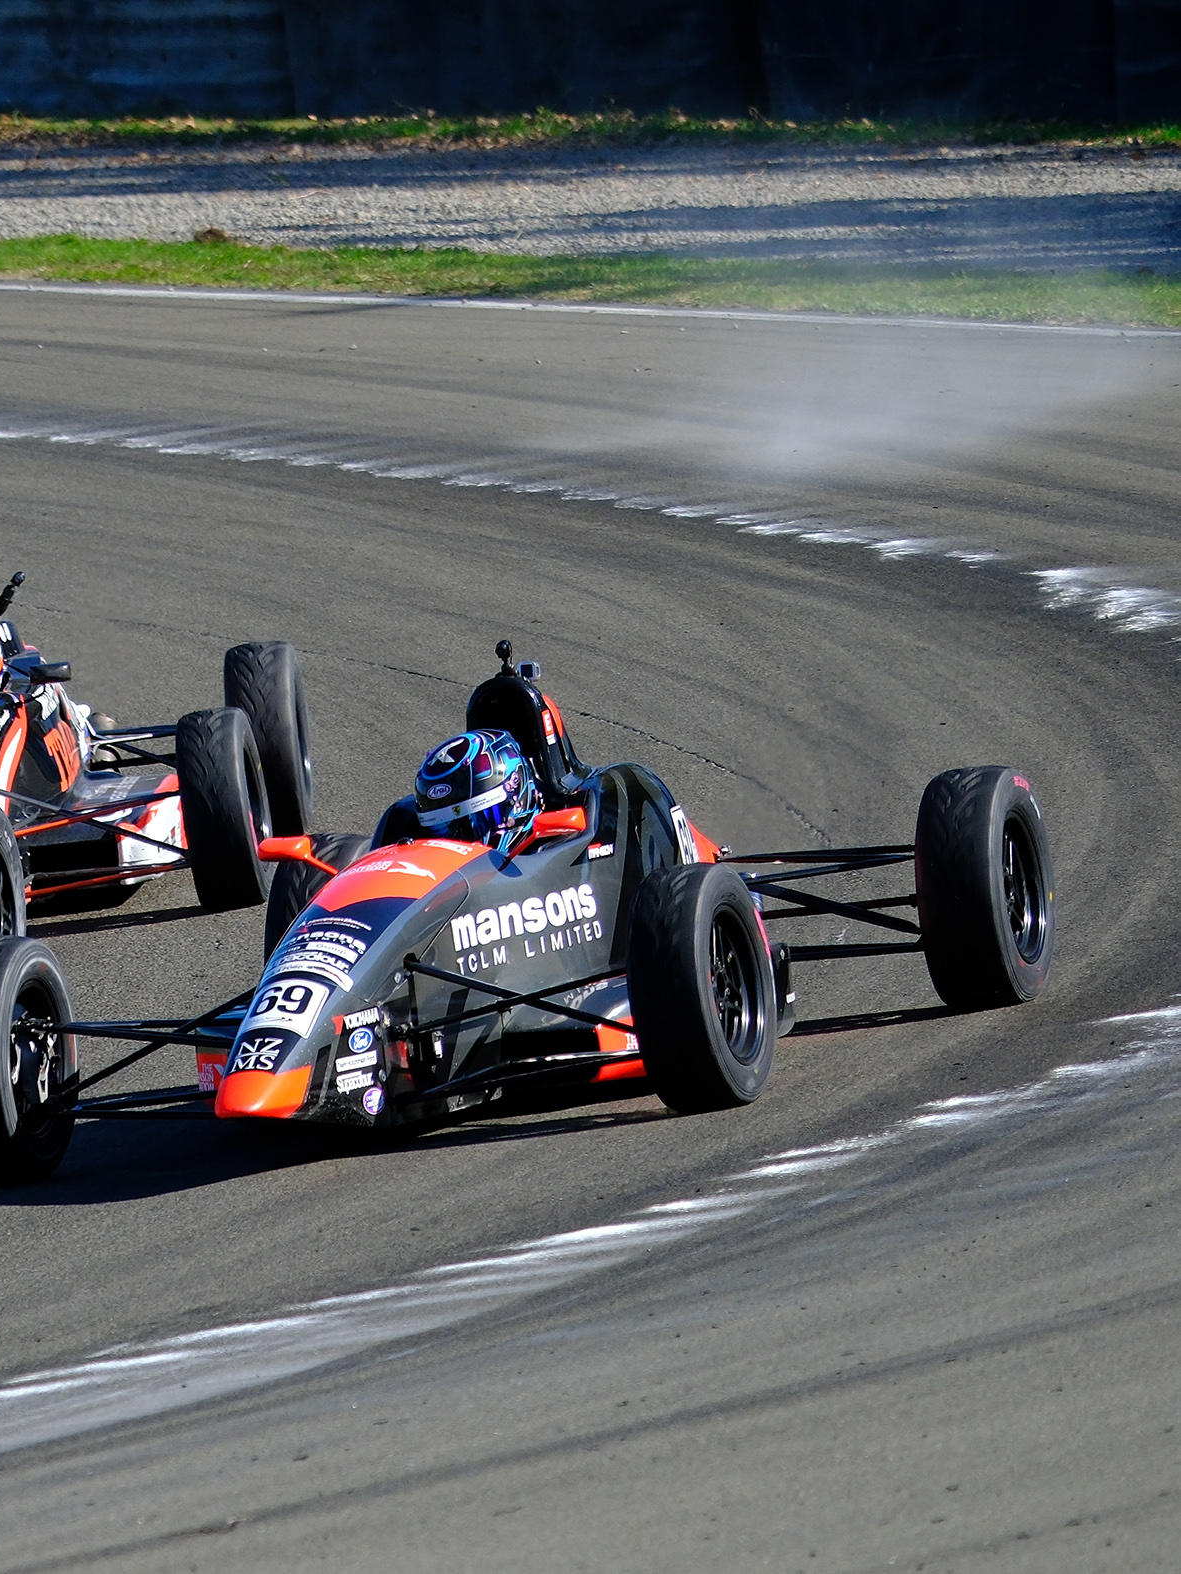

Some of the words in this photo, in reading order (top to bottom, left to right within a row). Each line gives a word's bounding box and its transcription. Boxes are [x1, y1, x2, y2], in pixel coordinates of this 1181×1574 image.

[429, 787, 450, 799] Arai
[450, 883, 598, 952] mansons
[456, 945, 507, 976] TCLM
[524, 919, 603, 959] LIMITED
[249, 985, 313, 1018] 69
[343, 1007, 379, 1030] YOKOHAMA
[238, 1037, 284, 1056] NZ
[202, 1063, 214, 1073] THE
[229, 1053, 276, 1074] MS
